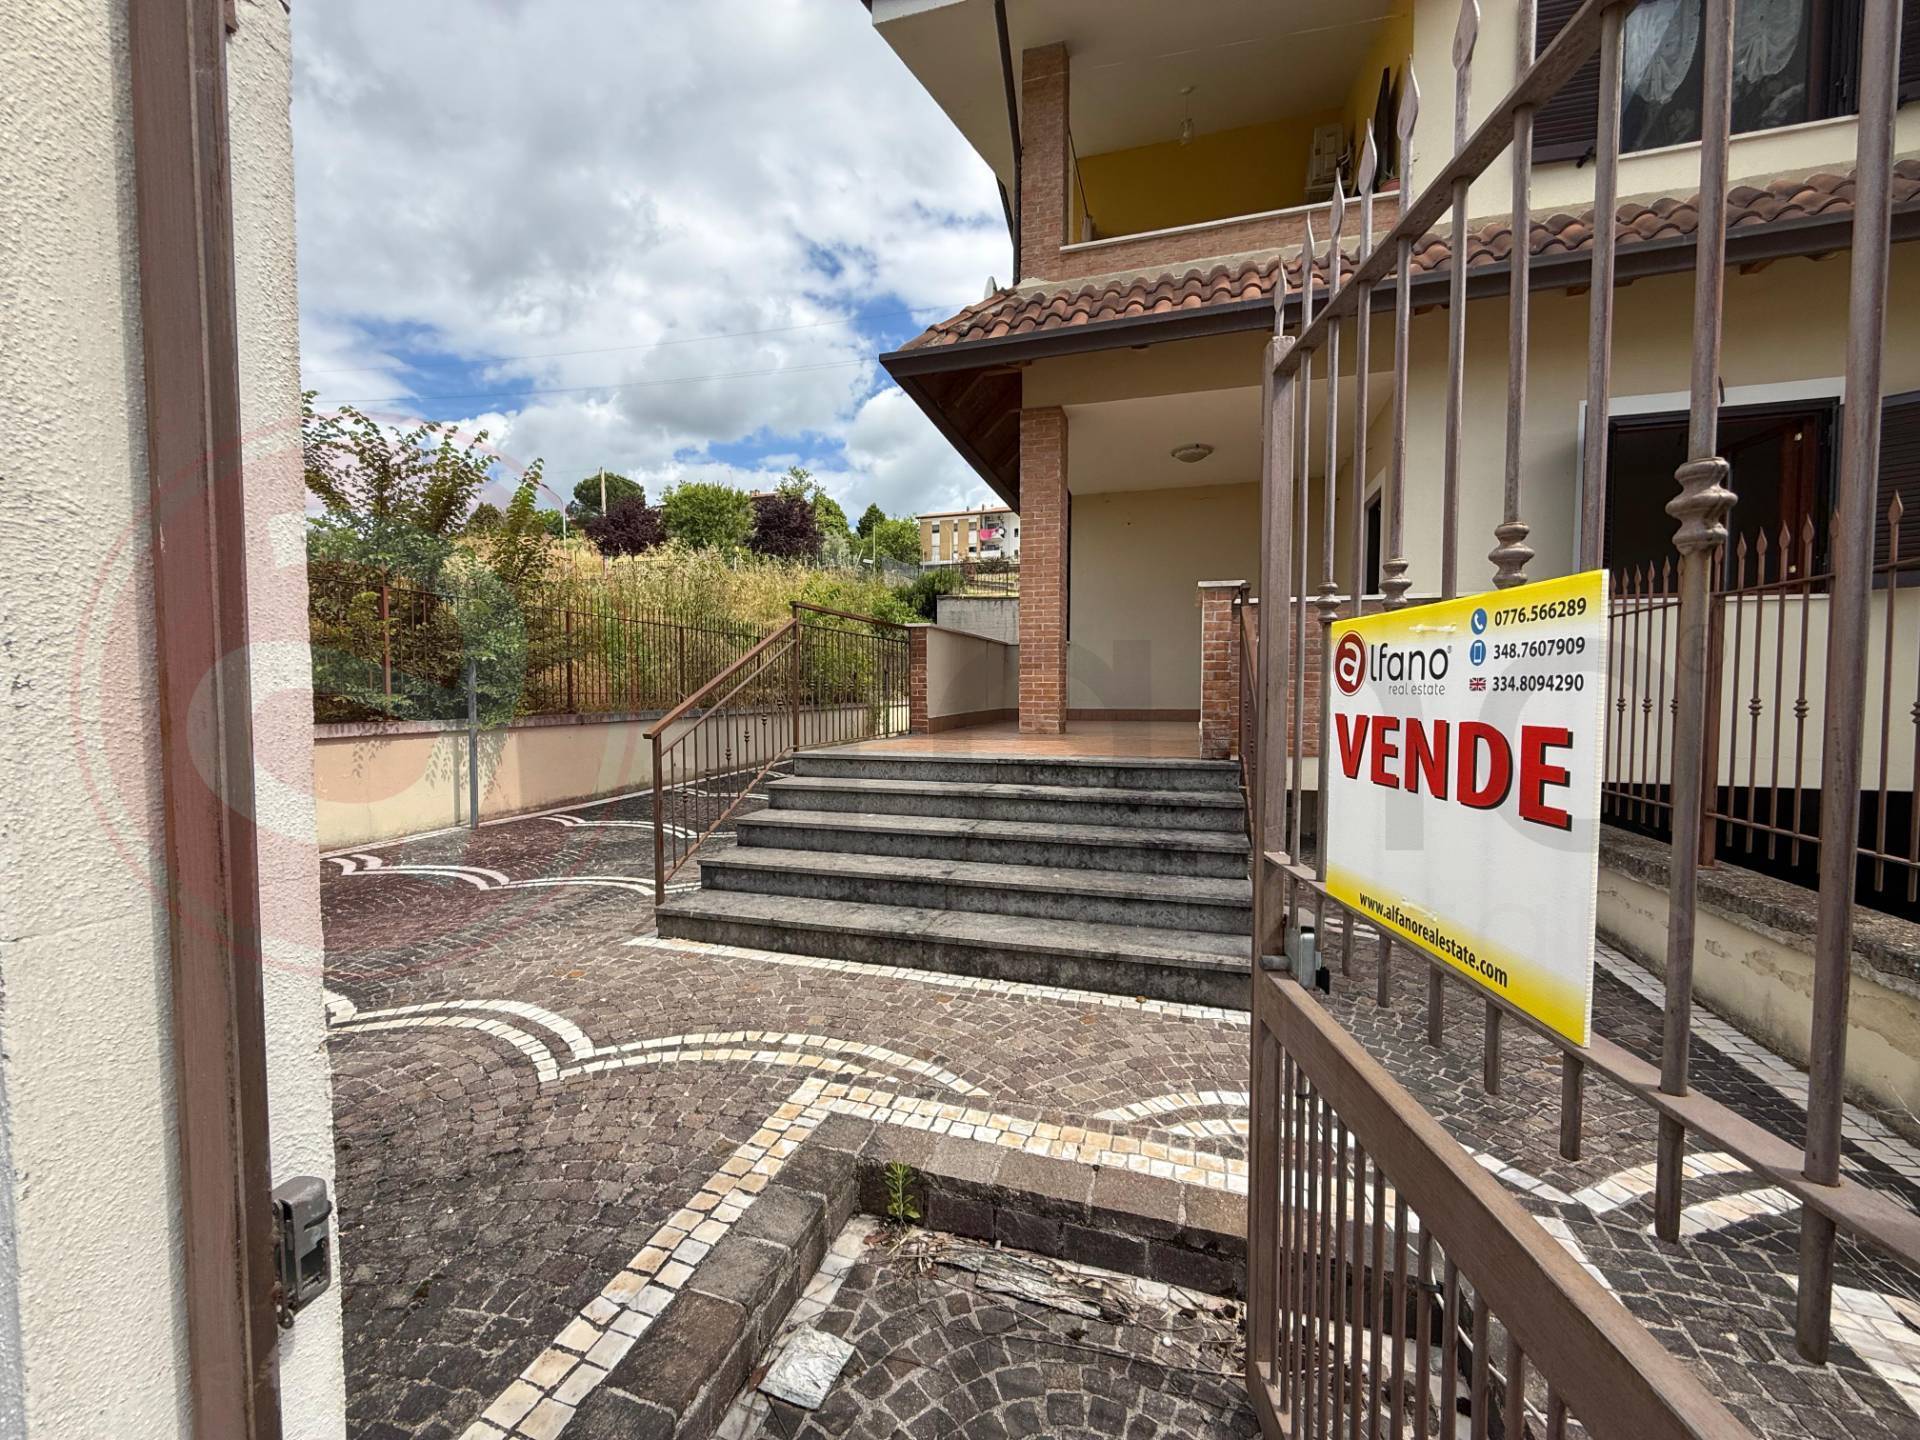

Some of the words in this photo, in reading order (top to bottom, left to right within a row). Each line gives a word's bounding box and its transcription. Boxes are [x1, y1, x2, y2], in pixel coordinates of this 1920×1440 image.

[1494, 597, 1587, 627] 0776.566289
[1493, 636, 1586, 660] 348.7607909
[1388, 683, 1408, 695] real
[1411, 683, 1446, 695] estate
[1492, 674, 1584, 692] 334.8094290
[1335, 713, 1573, 832] VENDE
[1359, 892, 1508, 988] www.alfanorealestate.com
